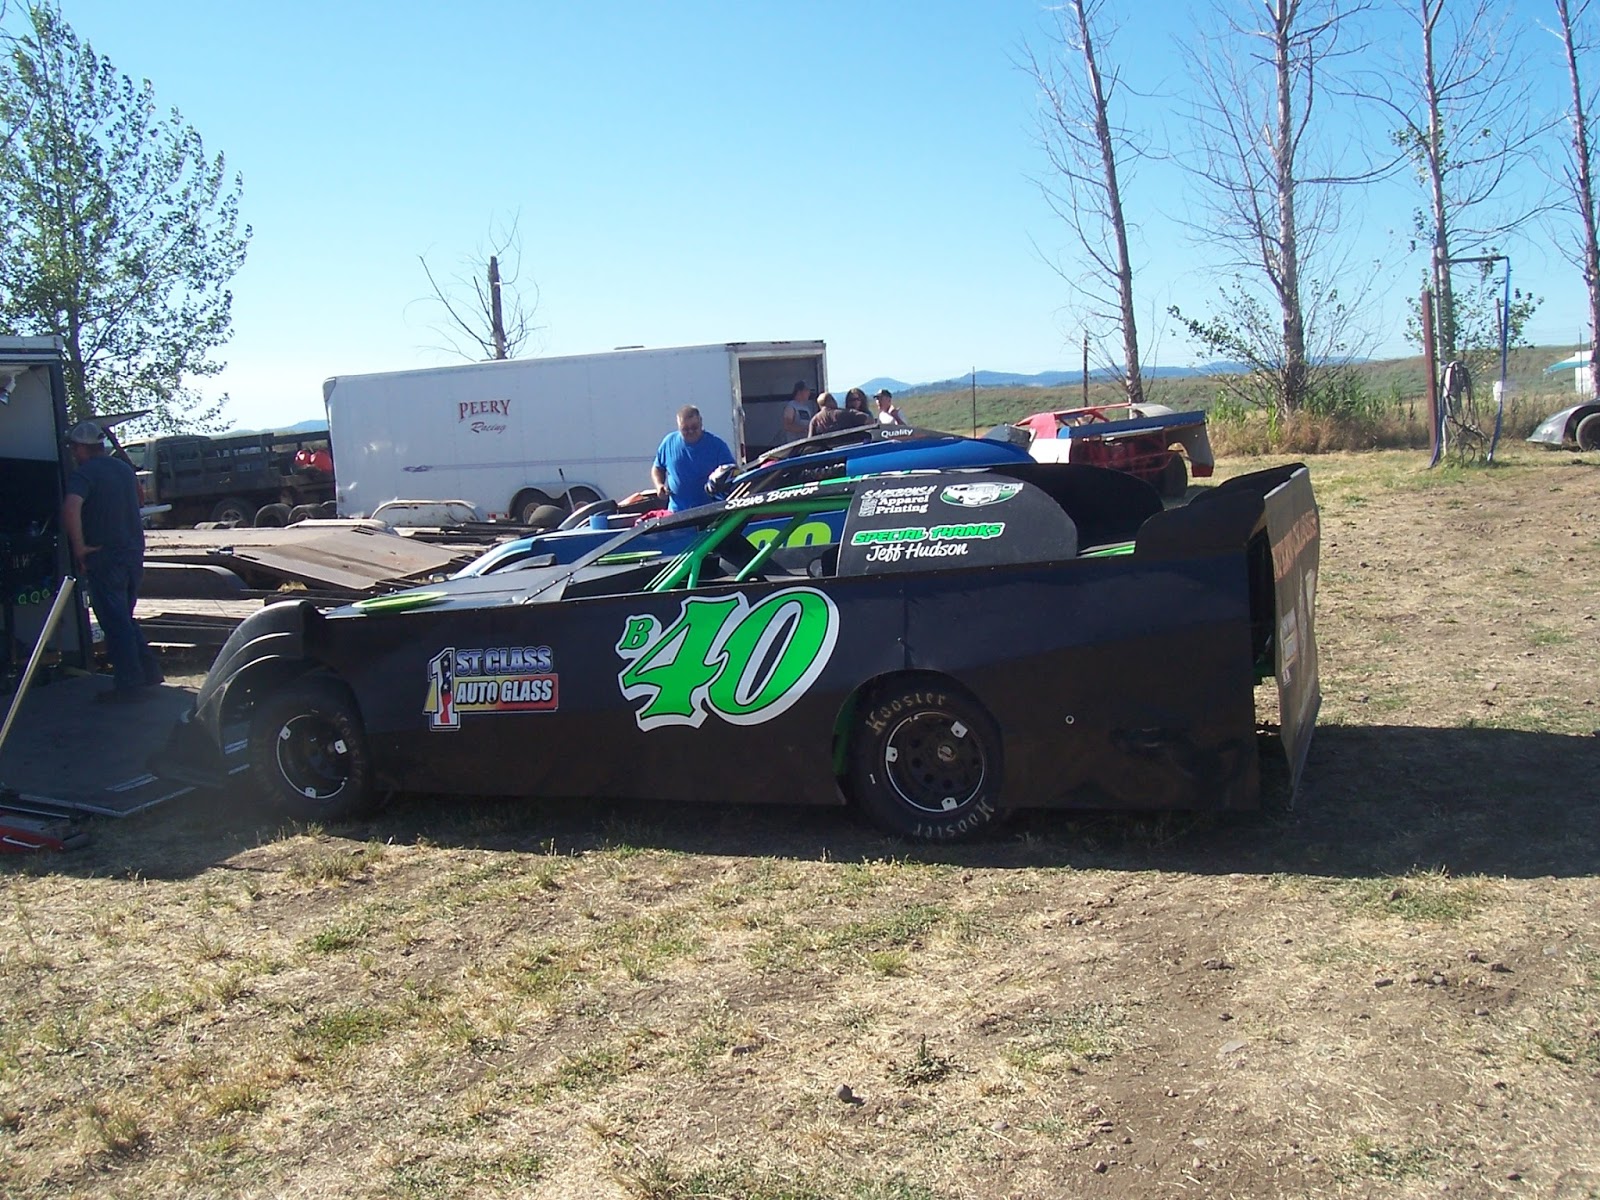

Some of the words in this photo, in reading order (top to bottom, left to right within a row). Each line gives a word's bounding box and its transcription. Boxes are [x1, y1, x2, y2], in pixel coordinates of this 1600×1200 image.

[458, 399, 511, 423] PEERY
[470, 421, 507, 434] Racing
[881, 428, 914, 439] Quality
[724, 494, 765, 510] Steve
[766, 486, 819, 503] Borror
[875, 503, 929, 515] Printing
[877, 493, 930, 506] Apparel
[851, 527, 929, 546] SPECIAL
[929, 522, 1006, 541] THANKS
[866, 544, 905, 562] Jeff
[905, 541, 969, 560] Hudson
[485, 647, 553, 674] CLASS
[455, 681, 499, 704] AUTO
[501, 679, 553, 702] GLASS
